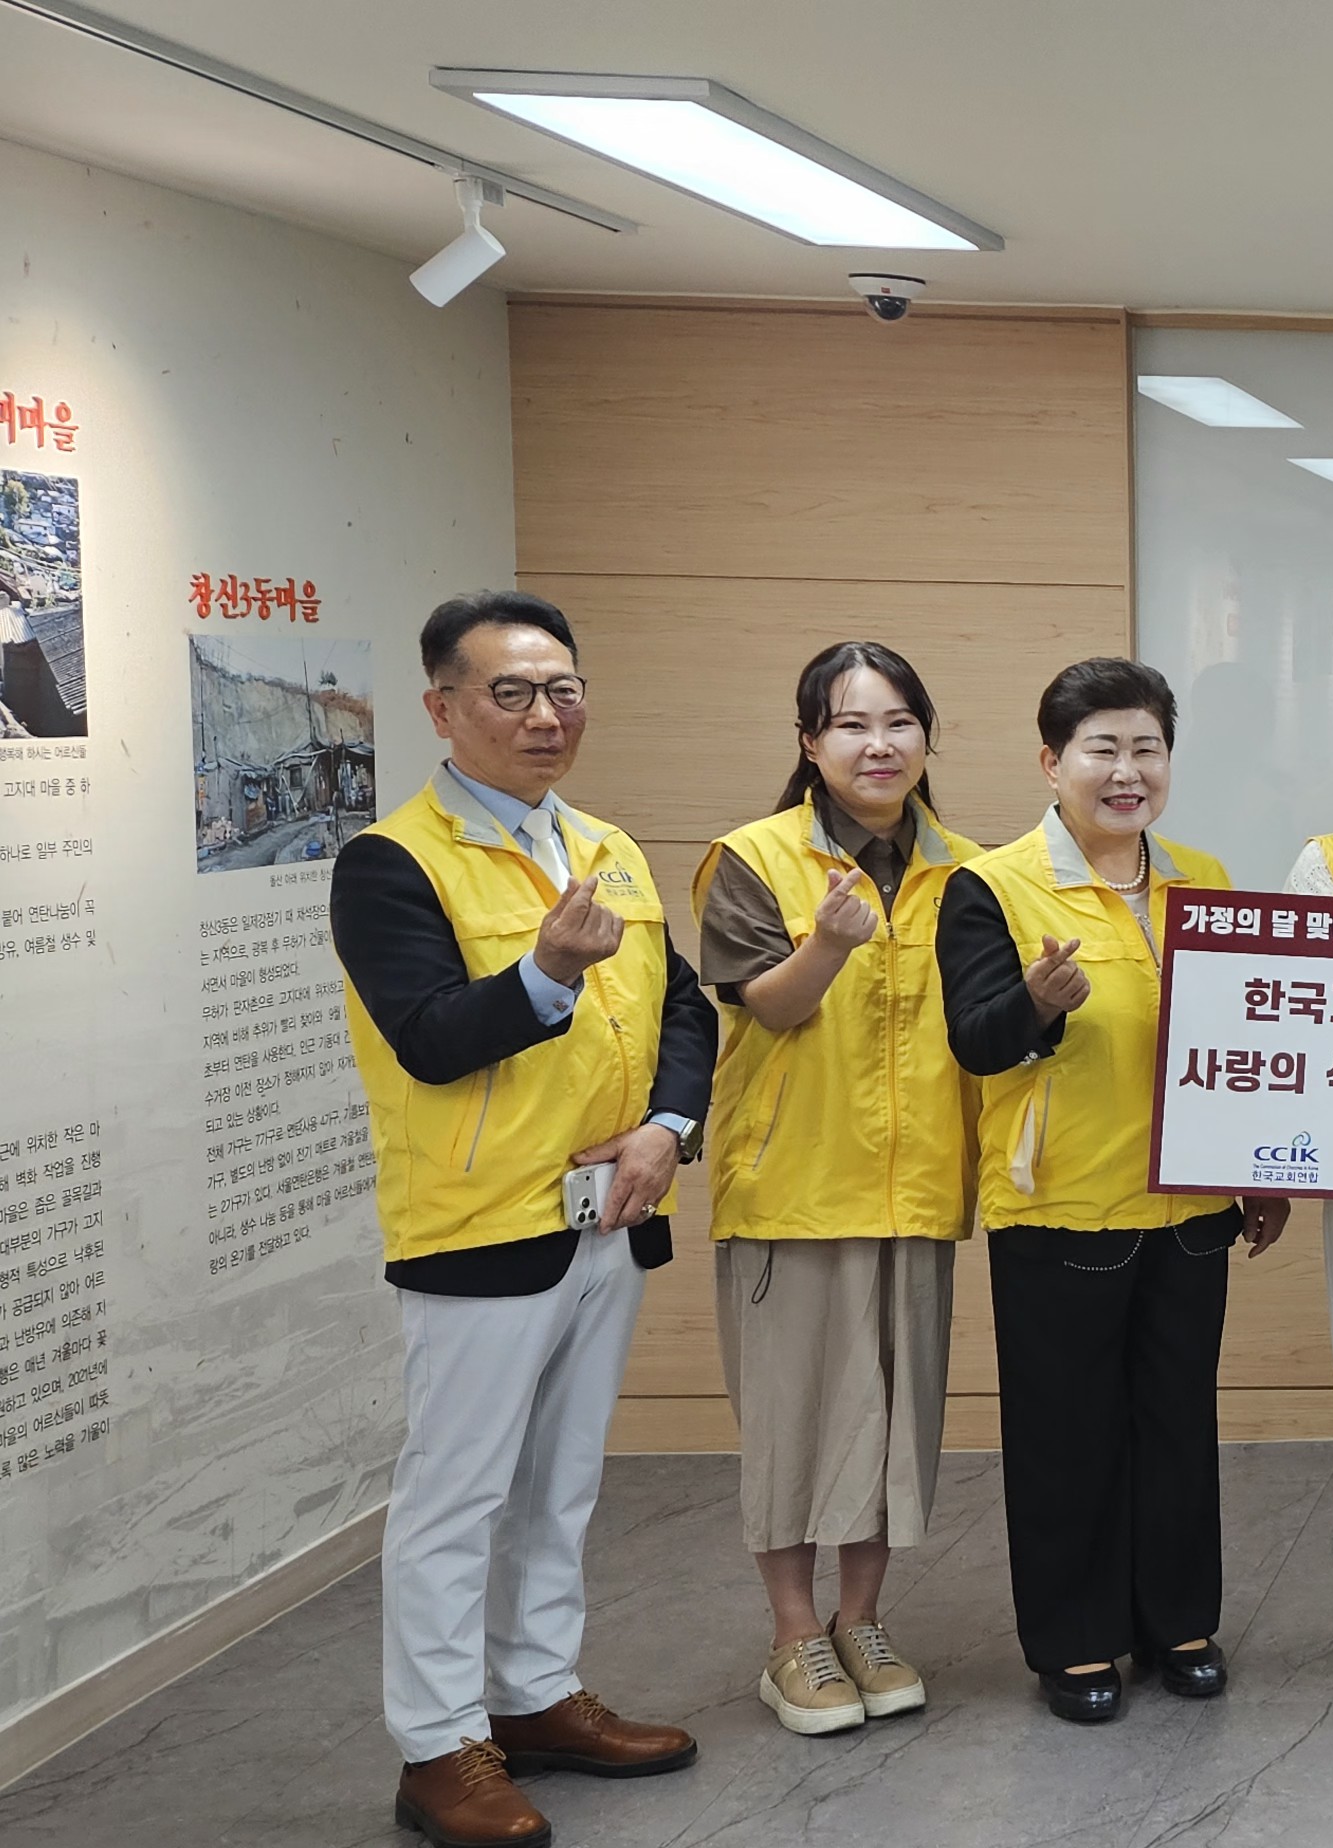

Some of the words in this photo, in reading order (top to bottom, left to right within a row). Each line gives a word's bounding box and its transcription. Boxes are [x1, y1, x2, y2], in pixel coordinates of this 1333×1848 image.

[188, 572, 321, 623] 창신3동마을
[26, 746, 51, 760] 하시는
[54, 744, 86, 759] 어르신들
[4, 780, 35, 797] 고지대
[40, 778, 60, 797] 마을
[65, 778, 76, 796] 중
[80, 777, 91, 795] 하
[0, 844, 31, 862] 하나로
[36, 841, 57, 860] 일부
[62, 838, 93, 857] 주민의
[29, 901, 80, 923] 연탄나눔이
[85, 899, 95, 915] 꼭
[200, 916, 238, 938] 창신3동은
[242, 909, 282, 931] 일제강점기
[1181, 904, 1261, 936] 가정의
[1271, 908, 1298, 940] 달
[25, 935, 56, 955] 여름철
[61, 932, 81, 951] 생수
[85, 930, 96, 947] 및
[200, 950, 210, 966] 는
[271, 938, 279, 953] 후
[282, 934, 306, 951] 무허가
[201, 975, 227, 993] 서면서
[230, 969, 256, 988] 마을이
[202, 1004, 229, 1021] 무허가
[233, 994, 275, 1016] 판자촌으로
[279, 984, 311, 1005] 고지대에
[203, 1030, 229, 1050] 지역에
[233, 1025, 250, 1043] 비해
[253, 1020, 277, 1039] 추위가
[204, 1058, 230, 1079] 초부터
[234, 1051, 259, 1072] 연탄을
[300, 1038, 316, 1055] 인근
[1179, 1047, 1307, 1095] 사랑의
[205, 1087, 231, 1107] 수거장
[235, 1080, 252, 1098] 이전
[27, 1130, 58, 1154] 위치한
[64, 1124, 84, 1143] 작은
[89, 1120, 100, 1137] 마
[205, 1116, 223, 1133] 되고
[226, 1112, 244, 1129] 있는
[206, 1143, 224, 1163] 전체
[227, 1136, 252, 1155] 가구는
[1253, 1146, 1319, 1163] CCIK
[16, 1166, 38, 1187] 벽화
[43, 1157, 74, 1180] 작업을
[81, 1150, 101, 1171] 진행
[230, 1161, 255, 1184] 별도의
[258, 1158, 274, 1175] 난방
[1252, 1170, 1318, 1183] 한국교회연합
[35, 1193, 56, 1215] 좁은
[62, 1179, 102, 1207] 골목길과
[208, 1204, 218, 1219] 는
[220, 1191, 250, 1214] 2가구가
[277, 1164, 330, 1196] 서울연탄은행은
[0, 1228, 41, 1255] 대부분의
[47, 1217, 78, 1241] 가구가
[83, 1209, 103, 1230] 고지
[240, 1217, 257, 1236] 생수
[259, 1212, 277, 1228] 나눔
[279, 1203, 295, 1222] 등을
[27, 1252, 68, 1278] 특성으로
[74, 1239, 104, 1263] 낙후된
[209, 1254, 228, 1276] 랑의
[230, 1245, 255, 1267] 온기를
[258, 1232, 291, 1257] 전달하고
[12, 1287, 54, 1317] 공급되지
[60, 1278, 79, 1301] 않아
[85, 1270, 105, 1289] 어르
[15, 1317, 56, 1348] 난방유에
[62, 1305, 91, 1328] 의존해
[96, 1299, 106, 1316] 지
[25, 1351, 46, 1374] 매년
[52, 1334, 92, 1363] 겨울마다
[31, 1376, 64, 1404] 있으며,
[68, 1358, 108, 1388] 2021년에
[33, 1398, 84, 1432] 어르신들이
[89, 1388, 109, 1410] 따뜻
[18, 1448, 39, 1473] 많은
[45, 1432, 75, 1460] 노력을
[81, 1417, 110, 1443] 기울이
